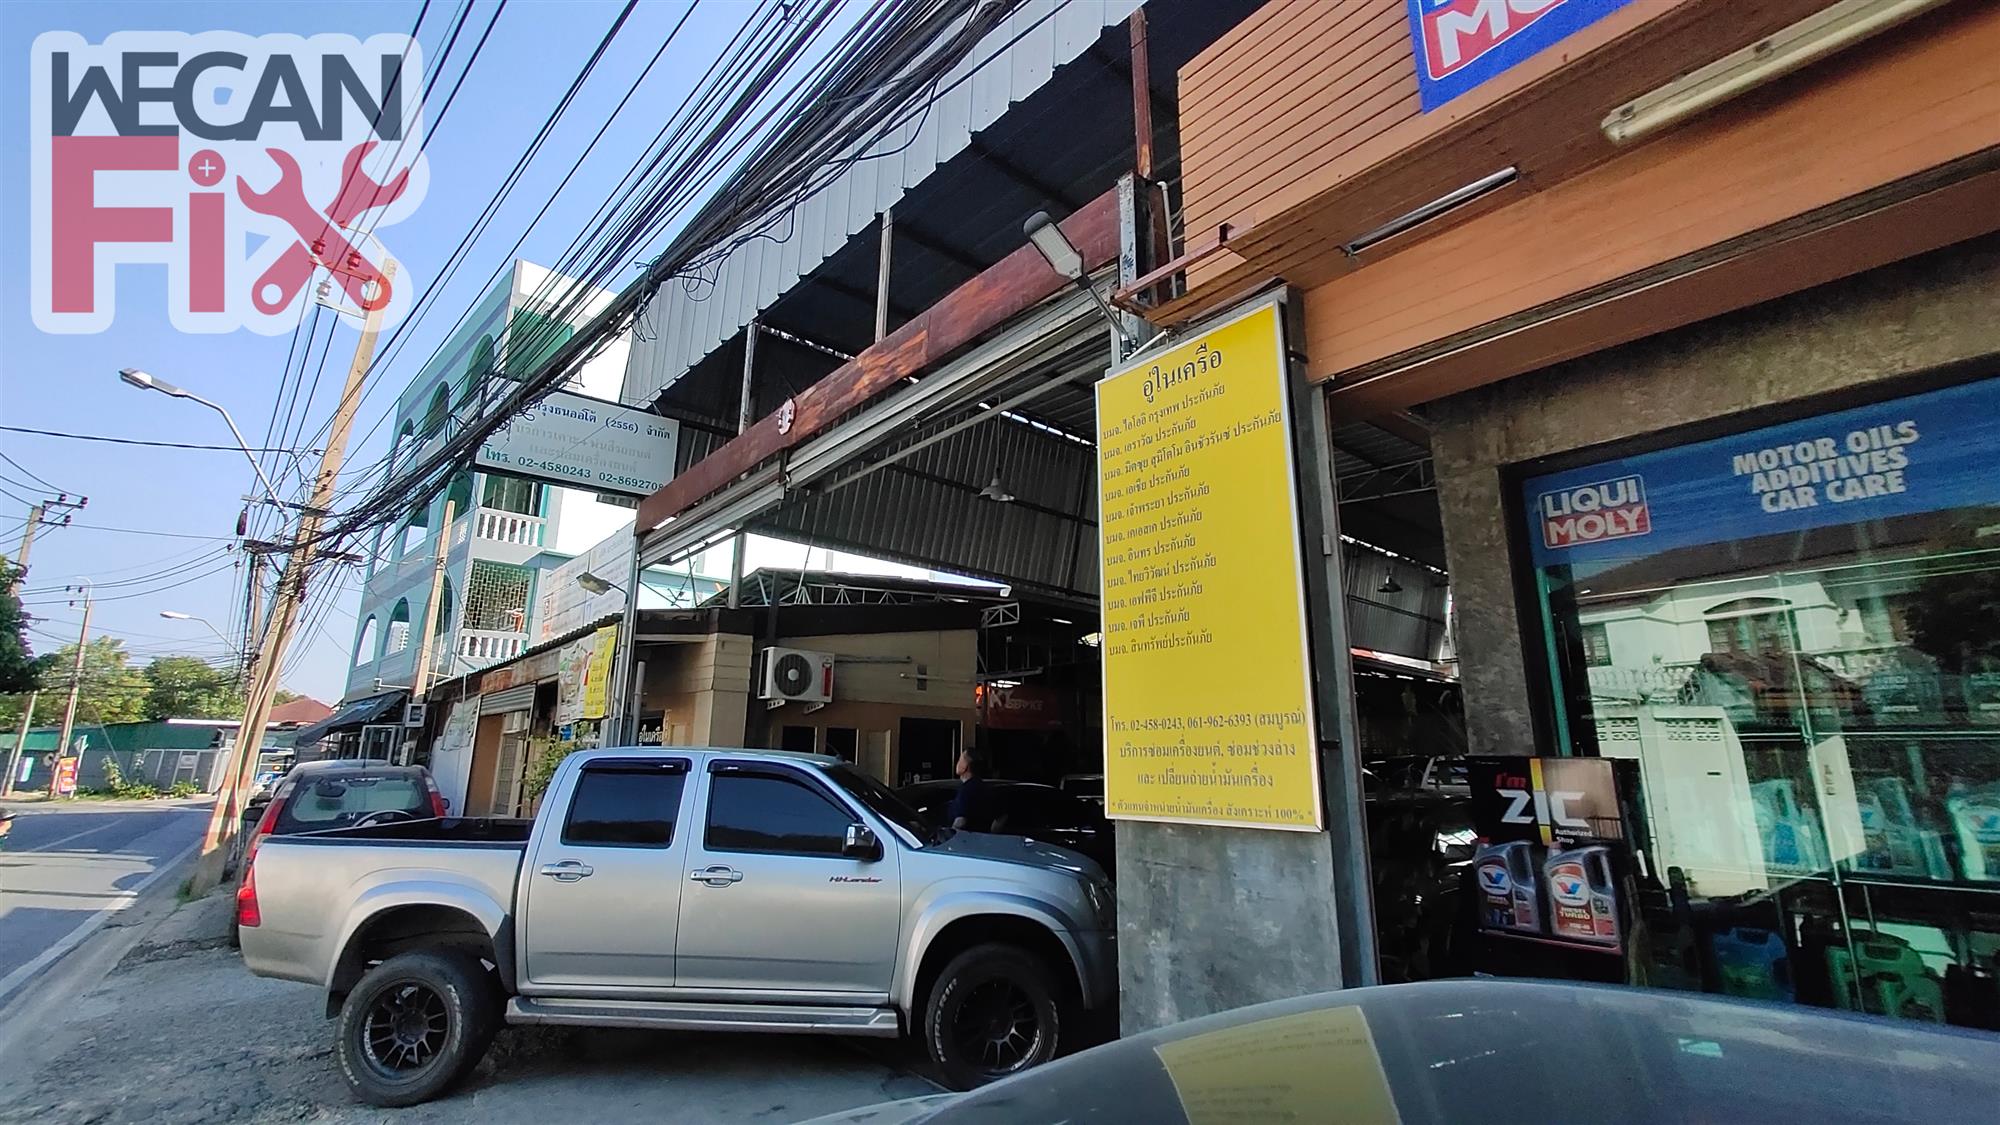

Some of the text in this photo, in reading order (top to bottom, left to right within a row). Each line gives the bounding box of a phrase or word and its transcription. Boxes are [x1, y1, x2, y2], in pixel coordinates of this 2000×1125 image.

[1143, 342, 1222, 403] อู่ในเครือ
[605, 416, 639, 434] (2556)
[646, 424, 671, 440] จำกัด
[1103, 427, 1122, 440] บมจ.
[1148, 403, 1180, 423] กรุงเทพ
[1182, 382, 1225, 409] ประกันภัย
[1104, 416, 1197, 460] บมจ. เอราวัณ ประกันภัย
[1104, 468, 1123, 480] บมจ.
[1233, 409, 1281, 437] ประกันภัย
[1732, 420, 1919, 476] MOTOR OILS
[483, 444, 511, 464] โทร.
[518, 456, 591, 478] 02-4580243
[1752, 446, 1909, 494] ADDITIVES
[1105, 464, 1190, 501] บมจ. เอเชีย ประกันภัย
[1545, 478, 1638, 518] LIQUI
[1760, 470, 1906, 514] CAR CARE
[1106, 481, 1210, 523] บมจ. เจ้าพระยา ประกันภัย
[1106, 532, 1125, 545] บมจ.
[1160, 507, 1203, 530] ประกันภัย
[1549, 505, 1645, 545] MOLY
[1107, 533, 1196, 566] บมจ. อินทร ประกันภัย
[1107, 552, 1217, 588] บมจ. ไทยวิวัฒน์ ประกันภัย
[1108, 599, 1127, 610] บมจ.
[1160, 580, 1203, 602] ประกันภัย
[1108, 622, 1128, 633] บมจ.
[1148, 607, 1190, 627] ประกันภัย
[1109, 628, 1213, 656] บมจ. สินทรัพย์ประกันภัย
[1110, 705, 1306, 732] โทร. 02-458-0243, 061-962-6393 (สมบูรณ์)
[1120, 733, 1296, 758] บริการซ่อมเครื่องยนต์, ซ่อมช่วงล่าง
[1137, 761, 1273, 788] และ เปลี่ยนถ่ายน้ำมันเครื่อง
[1275, 808, 1304, 820] 100%
[1496, 789, 1590, 828] ZIC
[1555, 828, 1593, 837] Authorized
[1556, 836, 1575, 844] Shop
